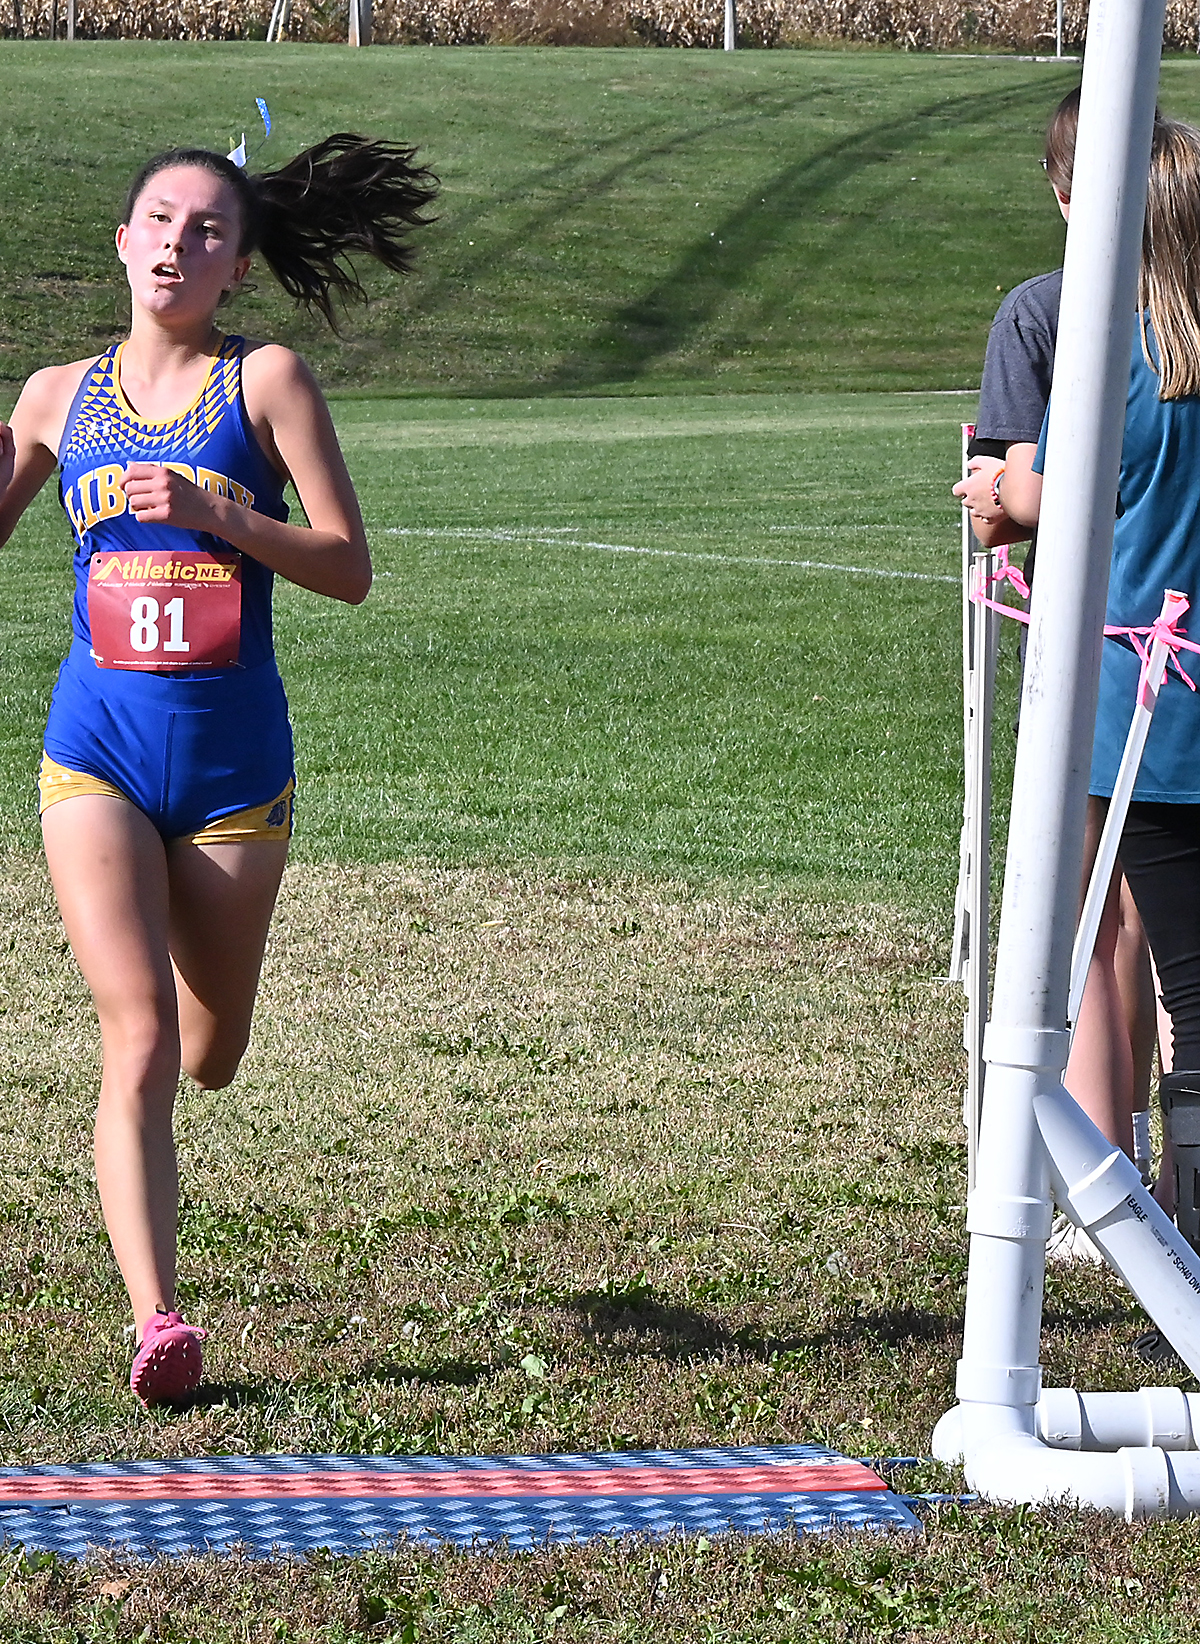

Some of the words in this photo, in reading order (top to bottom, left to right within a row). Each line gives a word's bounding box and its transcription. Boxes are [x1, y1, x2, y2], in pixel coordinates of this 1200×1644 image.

[92, 556, 197, 581] Athletic
[129, 596, 190, 652] 81
[1127, 1197, 1148, 1222] EAGLE
[1172, 1256, 1193, 1280] SCH40
